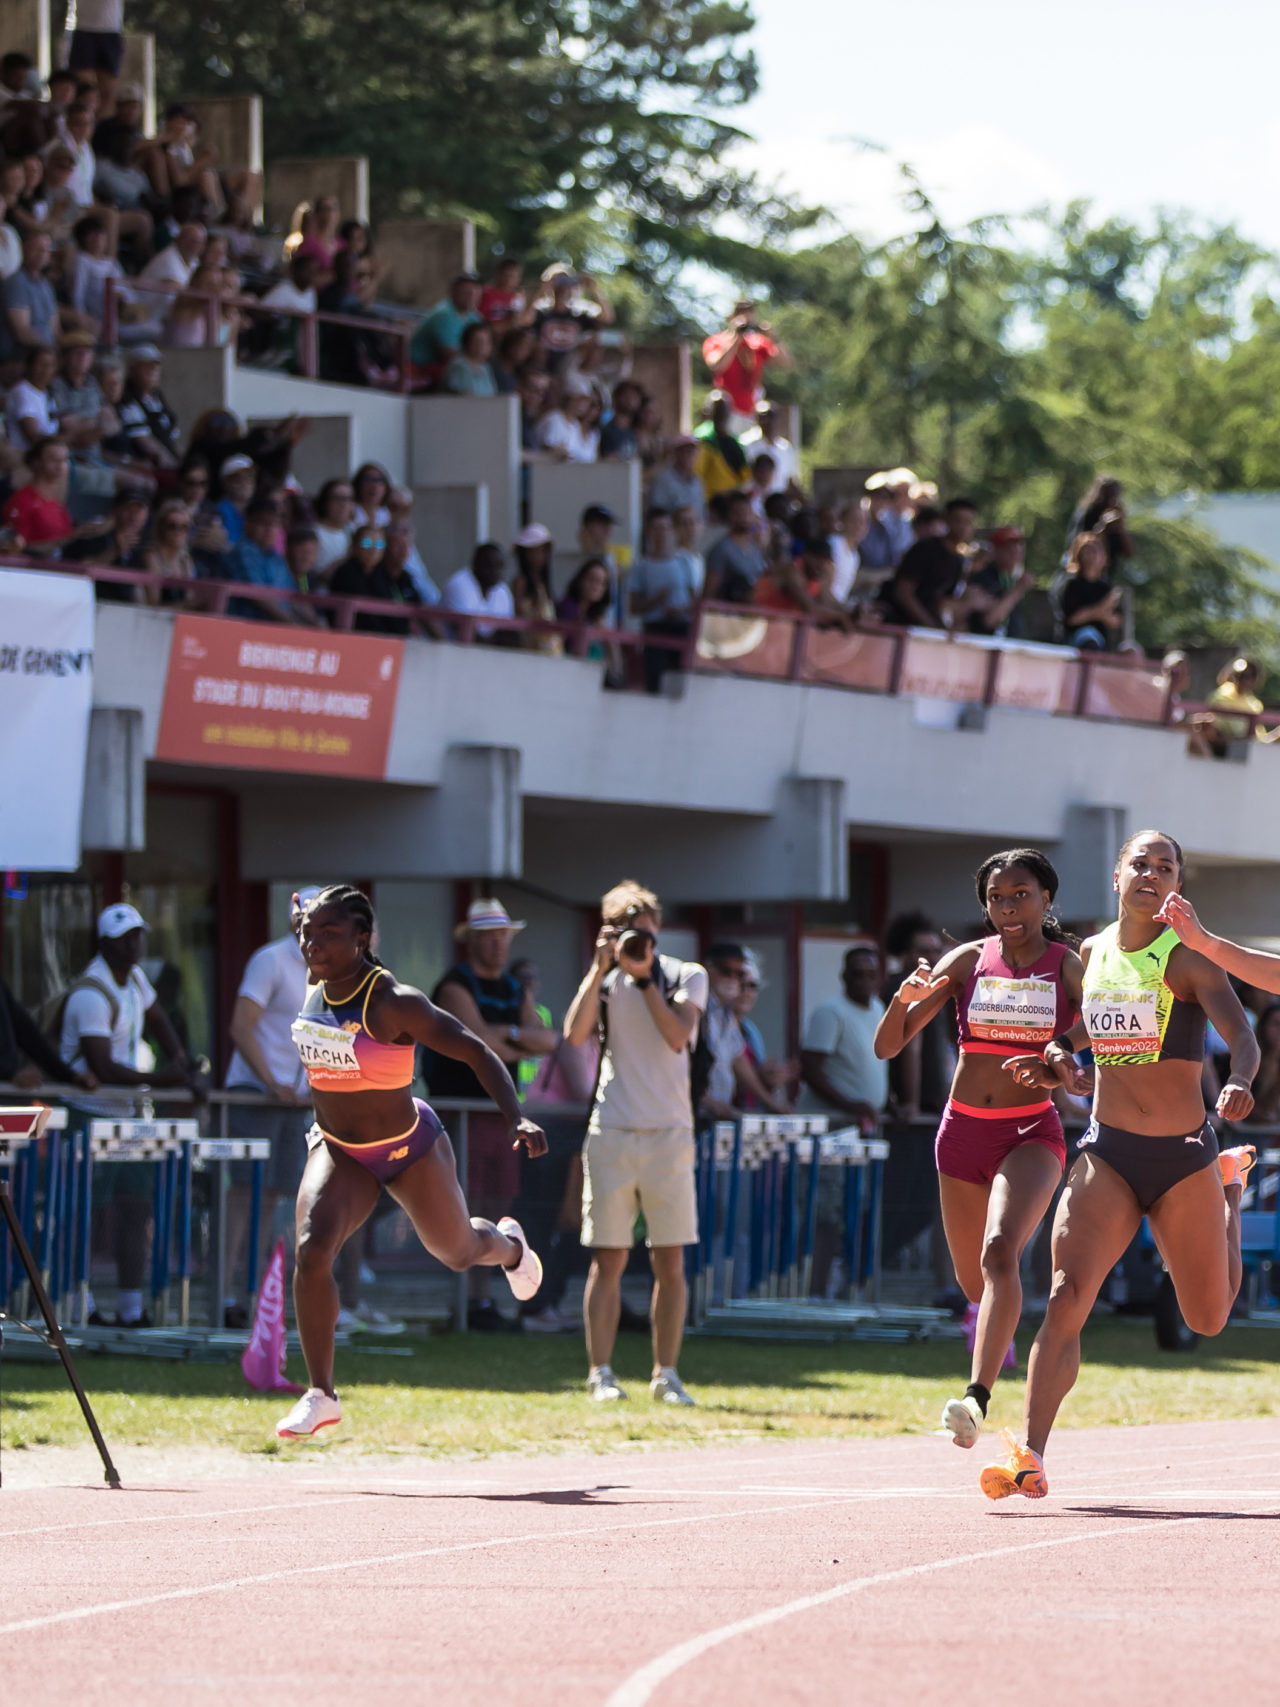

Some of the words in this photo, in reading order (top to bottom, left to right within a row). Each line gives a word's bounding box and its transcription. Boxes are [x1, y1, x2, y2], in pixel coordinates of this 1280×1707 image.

[319, 651, 341, 677] AU
[192, 676, 239, 706] STADE
[240, 681, 260, 708] DU
[970, 1003, 1054, 1016] WEDDERBURN-GOODISON
[1090, 1013, 1142, 1031] KORA
[990, 1028, 1051, 1041] Genève2022
[1098, 1041, 1159, 1053] Genève2022
